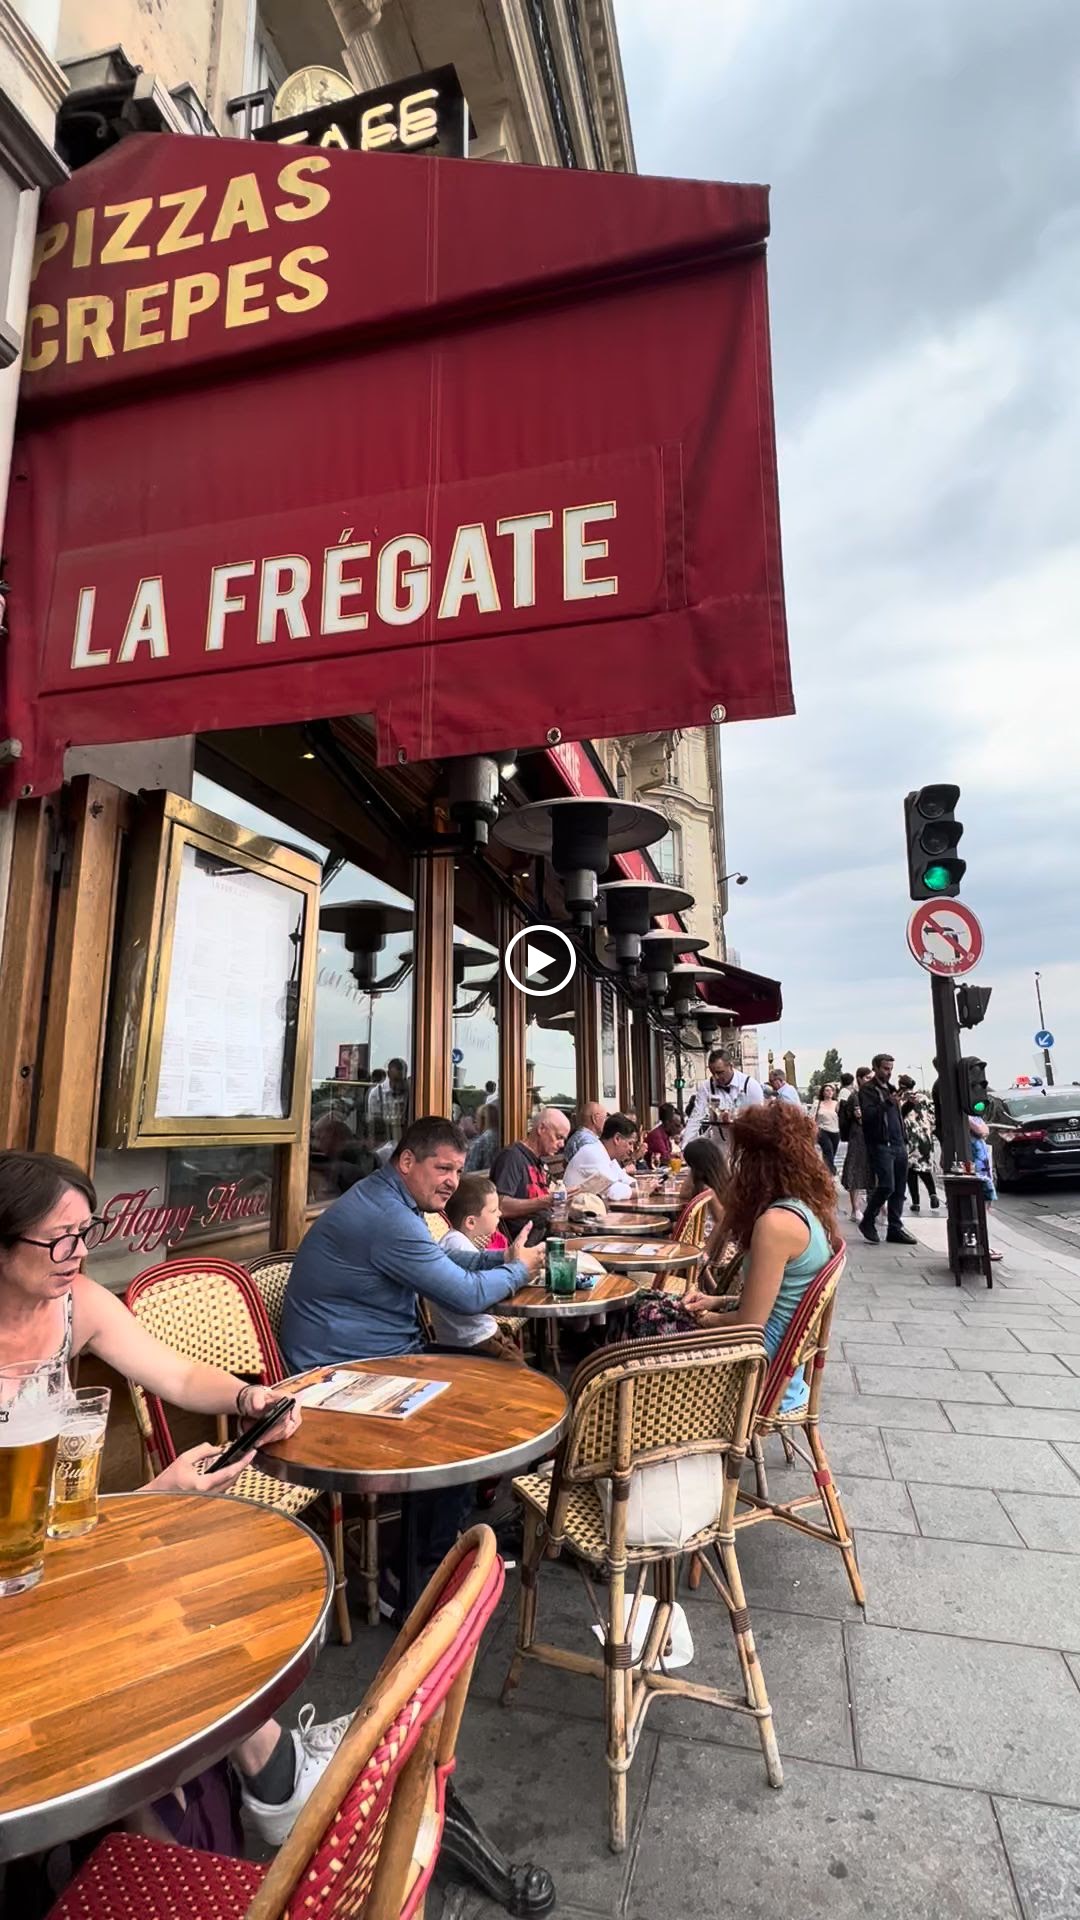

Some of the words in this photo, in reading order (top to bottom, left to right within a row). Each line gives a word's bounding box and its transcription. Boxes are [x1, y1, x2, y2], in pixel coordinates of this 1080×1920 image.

[31, 155, 331, 281] PIZZAS
[23, 245, 330, 372] CREPES
[70, 576, 170, 670] LA
[205, 500, 618, 652] FRÉGATE
[95, 1184, 195, 1253] Happy
